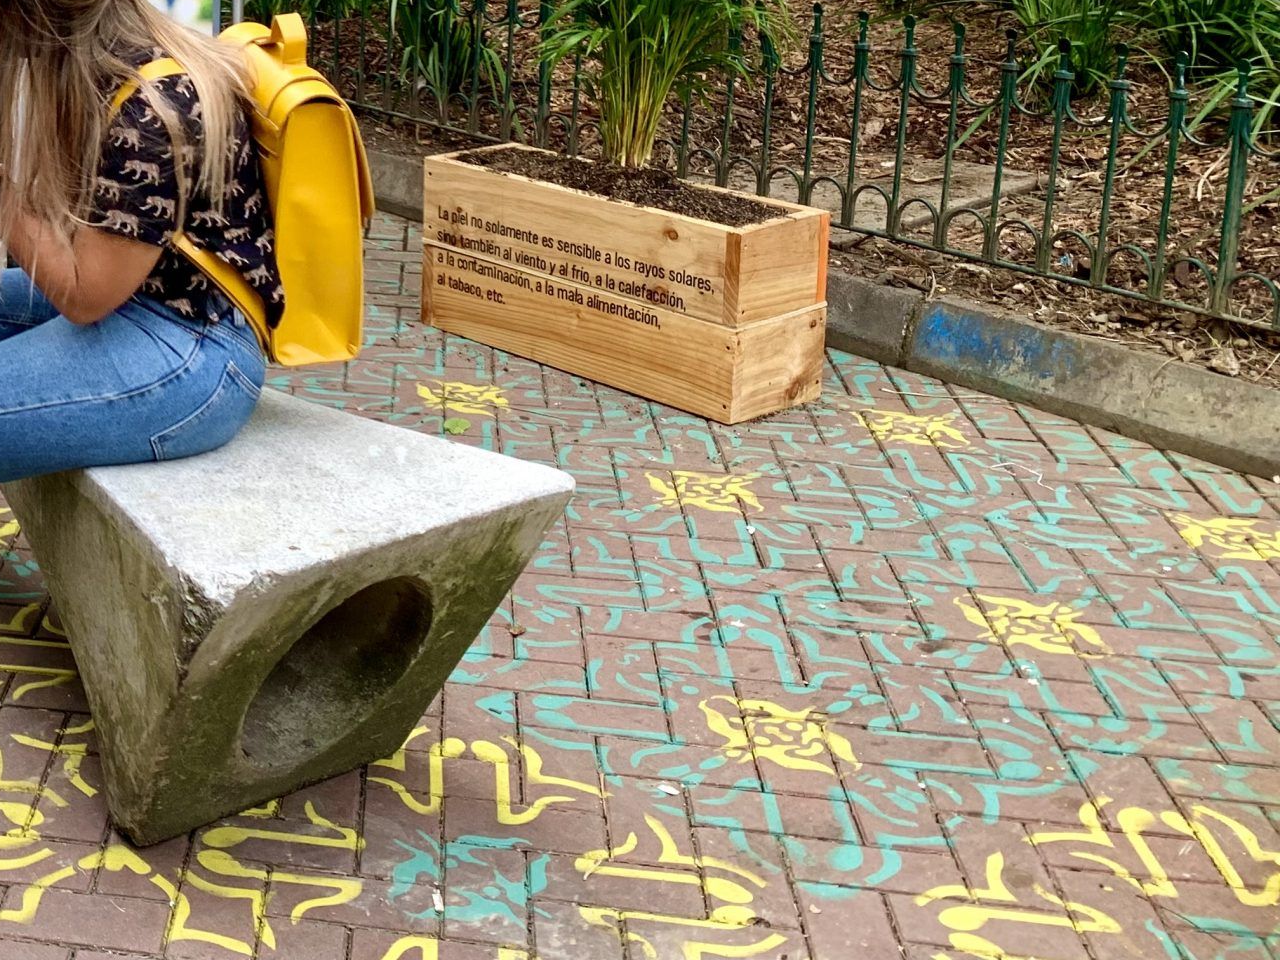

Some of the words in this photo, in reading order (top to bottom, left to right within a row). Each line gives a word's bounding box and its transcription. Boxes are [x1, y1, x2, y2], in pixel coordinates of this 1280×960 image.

[437, 205, 449, 221] La
[451, 209, 468, 226] piel
[471, 216, 483, 229] no
[485, 220, 538, 245] solamente
[542, 236, 554, 249] es
[557, 239, 601, 262] sensible
[604, 252, 612, 265] a
[614, 251, 631, 270] los
[634, 260, 665, 279] rayos
[668, 269, 715, 295] solares,
[437, 229, 457, 246] sino
[460, 234, 501, 257] también
[503, 246, 512, 261] al
[515, 250, 547, 271] viento
[549, 261, 556, 276] y
[559, 262, 569, 277] al
[595, 274, 603, 287] a
[605, 273, 615, 290] la
[618, 280, 687, 312] calefacción,
[437, 272, 446, 285] al
[448, 276, 484, 300] tabaco,
[486, 288, 507, 305] etc.
[437, 252, 444, 263] a
[446, 251, 455, 267] la
[457, 256, 534, 293] contaminación,
[535, 281, 542, 293] a
[545, 280, 555, 296] la
[557, 287, 584, 305] mala
[586, 294, 661, 330] alimentación,
